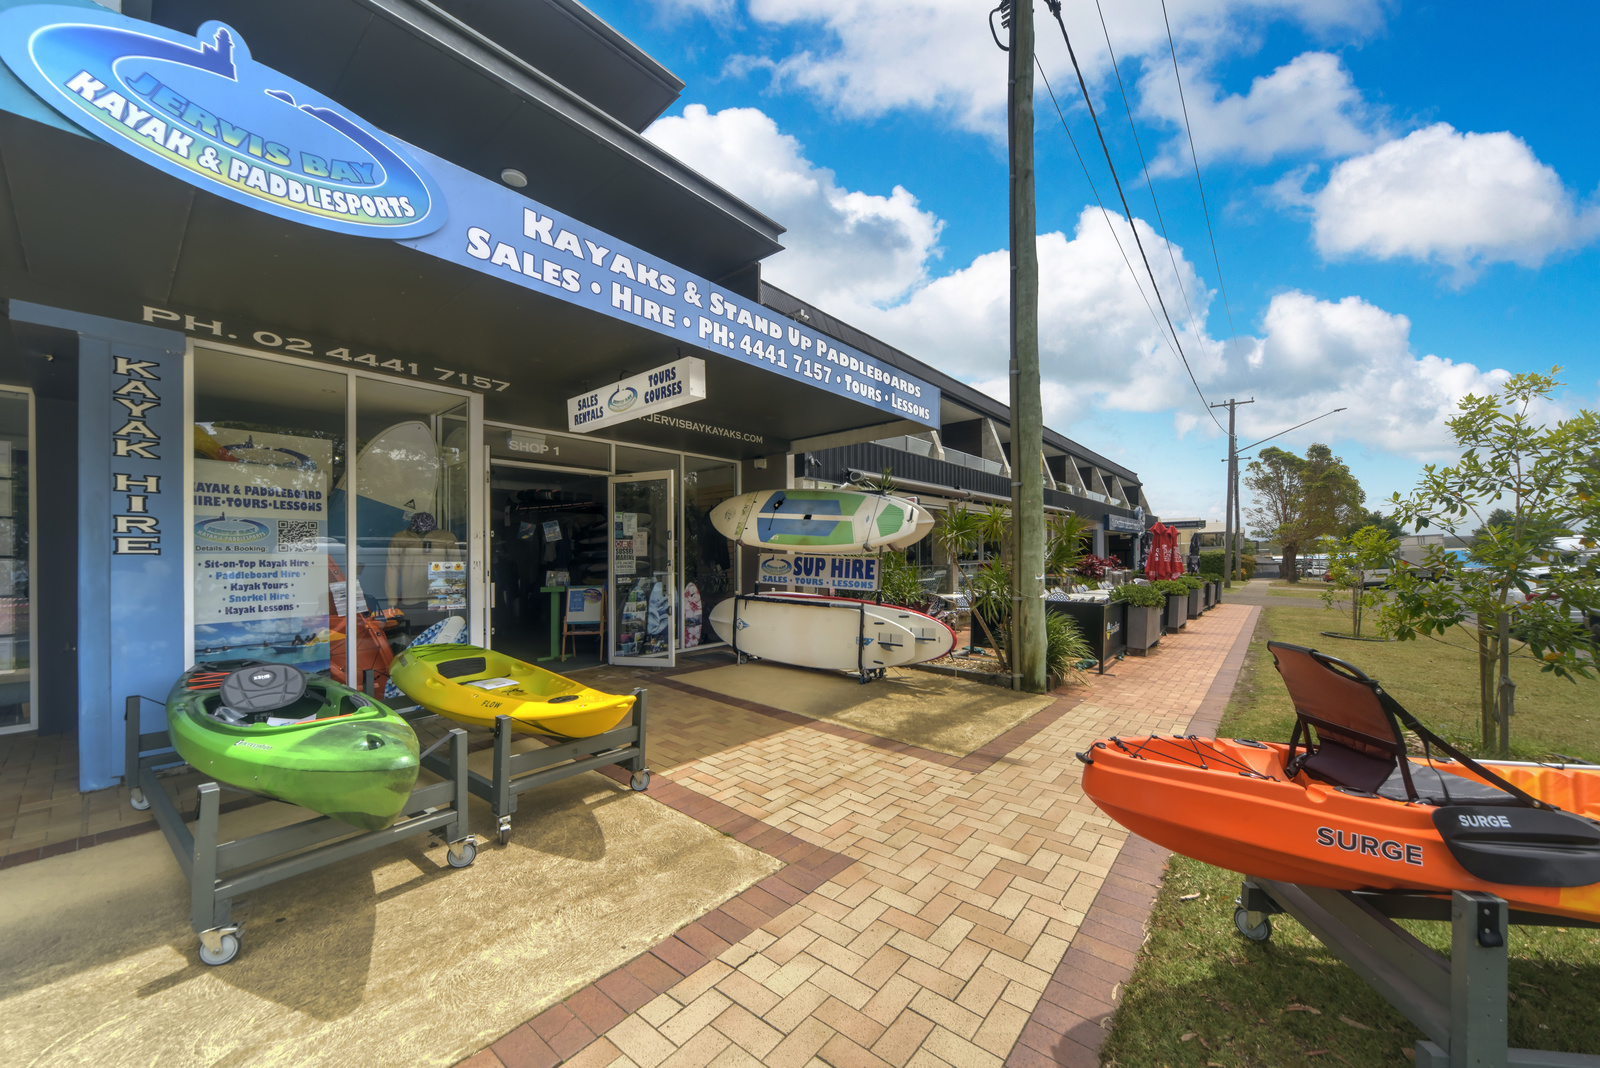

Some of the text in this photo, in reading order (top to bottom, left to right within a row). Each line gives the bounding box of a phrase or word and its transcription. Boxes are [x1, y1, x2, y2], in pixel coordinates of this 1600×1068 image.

[125, 71, 375, 186] JERVIS BAY
[64, 69, 416, 220] KAYAK & PADDLESPORTS
[523, 206, 677, 297] KAYAKS
[683, 280, 704, 309] &
[709, 291, 784, 340] STAND
[816, 337, 922, 399] PADDLEBOARDS
[466, 226, 931, 421] SALES HIRE PH: 4441 7157 TOURS LESSONS
[142, 305, 511, 392] PH. 02 4441 7157
[648, 366, 677, 388] TOURS
[644, 380, 683, 404] COURSES
[577, 393, 599, 412] SALES
[574, 406, 604, 426] RENTALS
[639, 413, 764, 444] .JERVISBAYKAYAKS.COM
[112, 354, 162, 556] KAYAK HIRE
[508, 439, 560, 456] SHOP 1
[233, 484, 241, 495] &
[244, 485, 322, 500] PADDLEBOARD
[226, 496, 269, 509] TOURS
[273, 500, 322, 512] LESSONS
[234, 545, 268, 553] Booking:
[204, 558, 309, 569] Sit-on-Top Kayak Hire
[793, 556, 826, 577] SUP
[215, 570, 300, 580] Paddleboard Hire
[762, 575, 873, 589] SALES TOURS LESSONS
[230, 582, 288, 592] Kayak Tours
[228, 594, 267, 603] Snorkel
[225, 603, 294, 616] Kayak Lessons
[481, 700, 503, 709] FLOW
[1458, 814, 1512, 828] SURGE
[1316, 826, 1424, 867] SURGE
